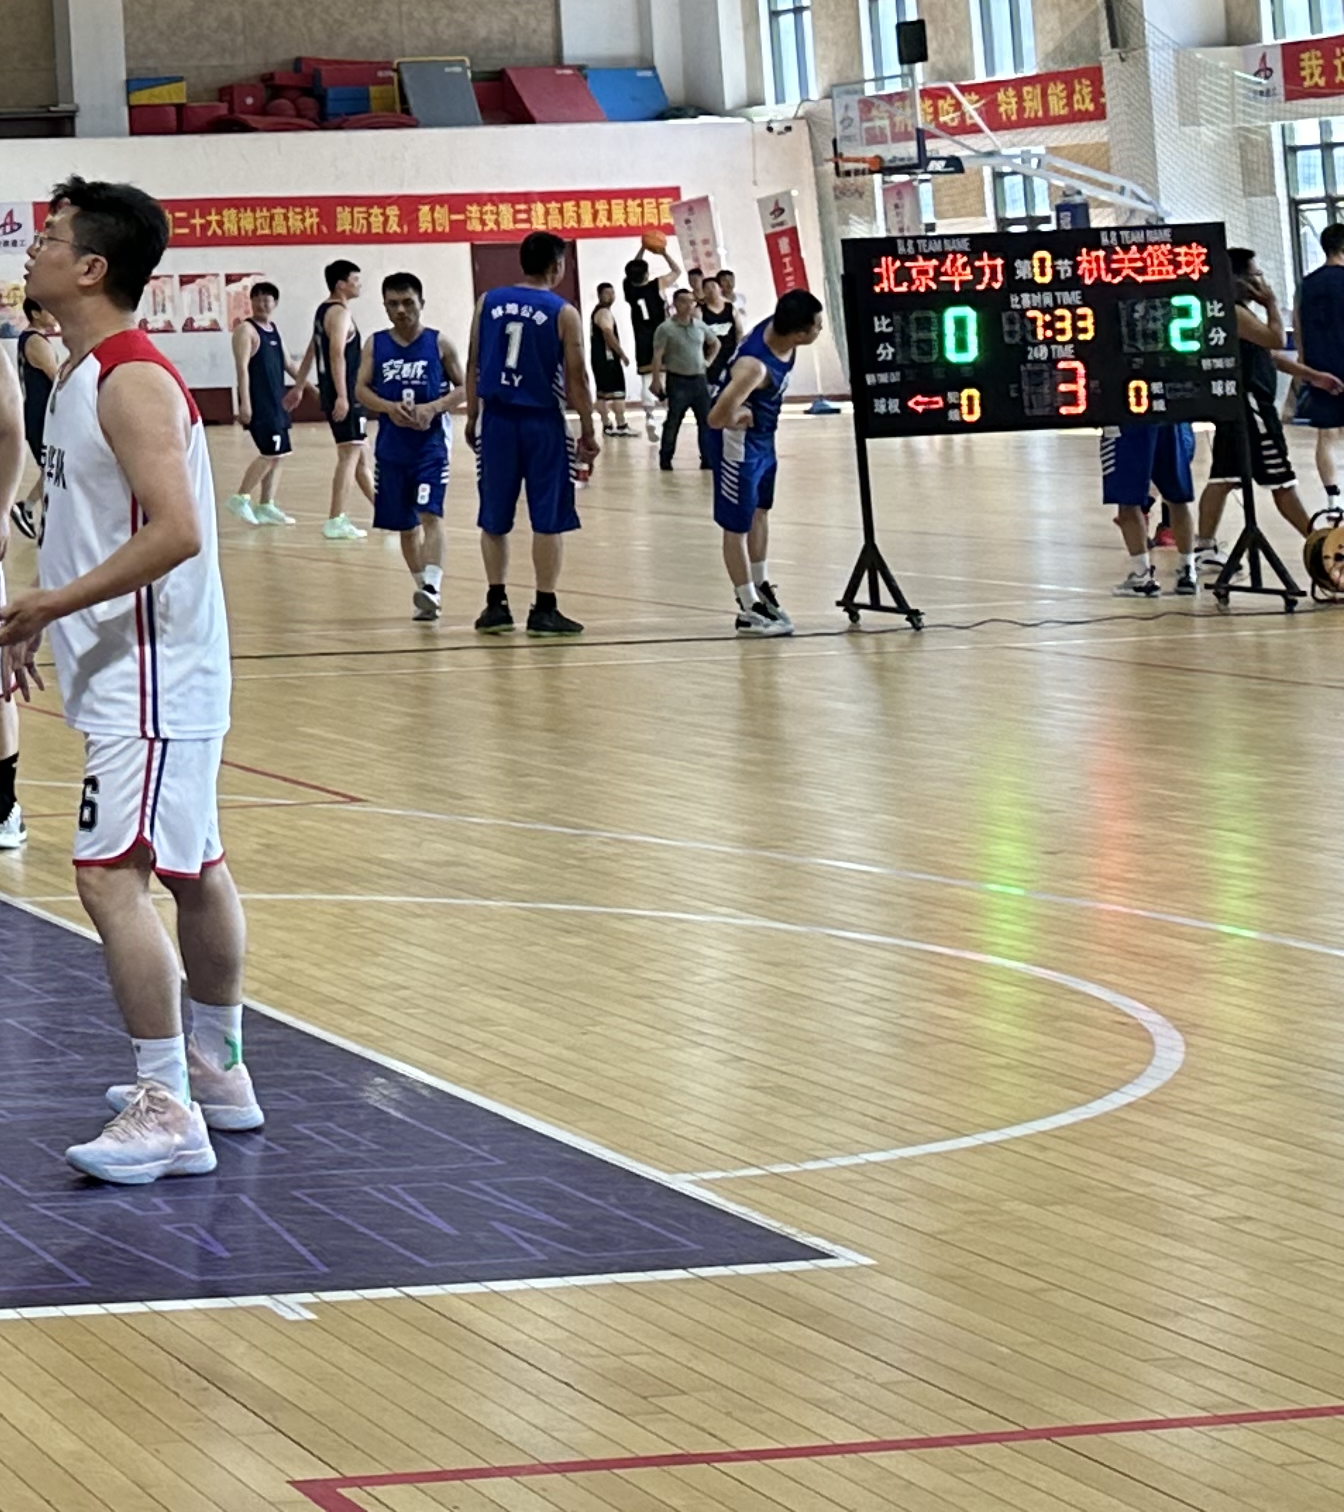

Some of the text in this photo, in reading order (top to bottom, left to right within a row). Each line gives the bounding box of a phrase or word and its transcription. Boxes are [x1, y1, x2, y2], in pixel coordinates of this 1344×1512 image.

[997, 80, 1106, 123] 特别能战
[873, 250, 1005, 293] 北京华力
[1031, 250, 1053, 284] 0
[1076, 242, 1209, 286] 机关篮球
[636, 297, 651, 322] 1
[1055, 290, 1083, 306] TIME
[942, 305, 980, 364] 0
[1025, 306, 1096, 342] 7:33
[1168, 294, 1203, 353] 2
[505, 321, 525, 370] 1
[1051, 343, 1076, 359] TIME
[500, 371, 524, 388] LY
[1055, 360, 1088, 415] 3
[1127, 380, 1150, 415] 0
[960, 387, 982, 423] 0
[272, 434, 282, 452] 7
[416, 483, 431, 506] 8
[78, 774, 101, 833] 6
